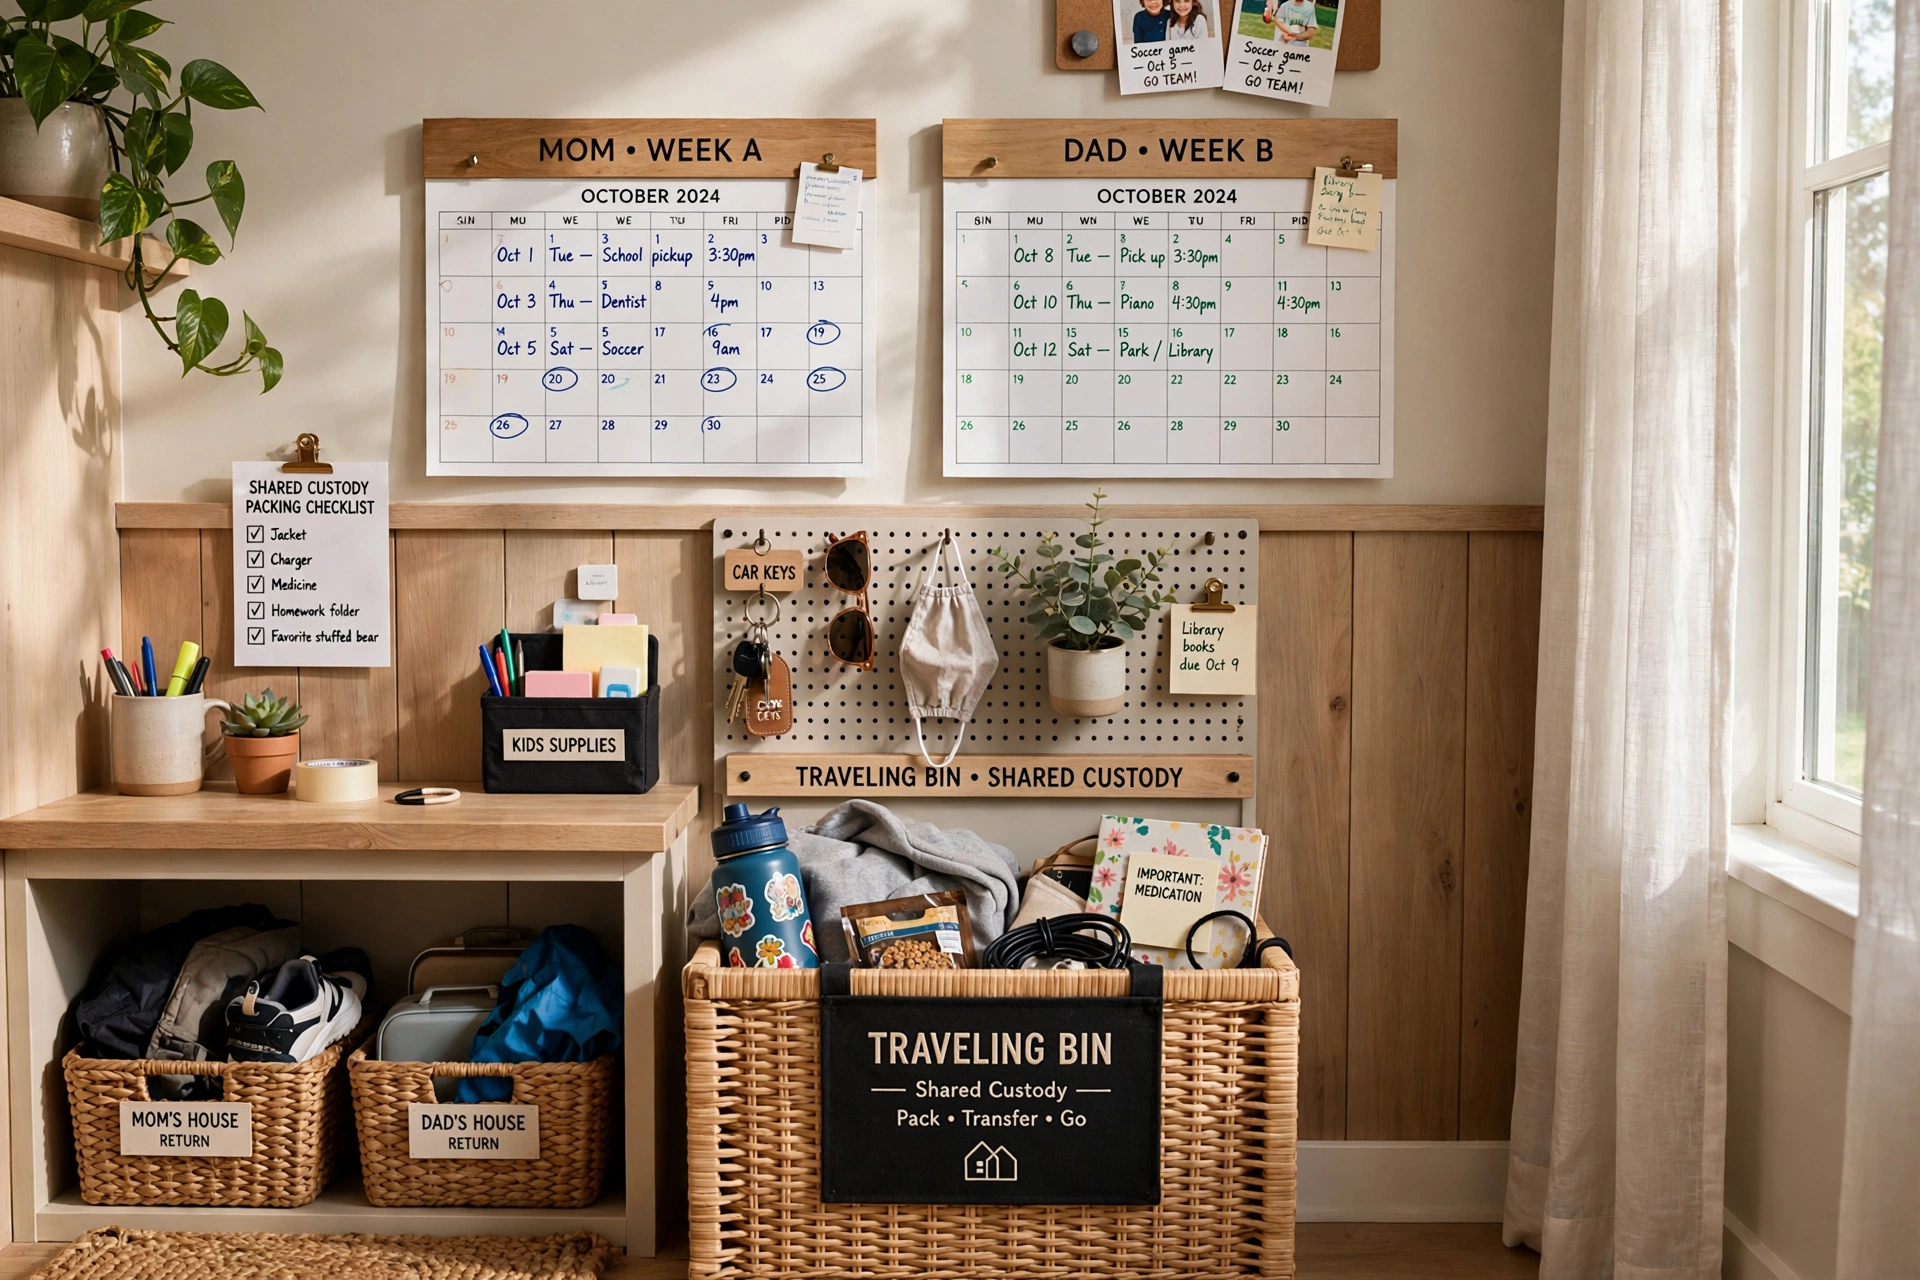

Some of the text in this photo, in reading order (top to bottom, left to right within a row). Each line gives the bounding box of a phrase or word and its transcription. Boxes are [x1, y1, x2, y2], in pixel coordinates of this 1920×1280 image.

[1131, 45, 1195, 59] Soccer game
[1244, 41, 1311, 65] Soccer game
[1148, 58, 1177, 72] Oct 5
[1254, 59, 1285, 75] Oct 5
[1144, 71, 1198, 87] GO TEAM!
[1245, 75, 1303, 94] GO TEAM!
[539, 138, 762, 162] MOM WEEK A
[1065, 139, 1273, 162] DAD WEEK B
[582, 189, 720, 203] OCTOBER 2024
[1098, 189, 1237, 203] OCTOBER 2024
[563, 216, 578, 224] WE
[616, 216, 631, 225] WE
[723, 217, 737, 225] FRI
[1028, 217, 1043, 225] MU
[1133, 217, 1149, 225] WE
[498, 247, 520, 262] Oct
[549, 247, 573, 262] Tue
[603, 247, 642, 262] School
[652, 247, 692, 267] pickup
[709, 248, 754, 267] 3:30pm
[1014, 247, 1218, 268] Oct 8 Tue Pick up 3:30pm
[761, 281, 824, 290] 10 13
[1279, 281, 1341, 291] 11 13
[497, 293, 738, 313] Oct 3 Thu Dentist 4pm
[1014, 294, 1320, 315] Oct 10 Thu Piano 4:30pm 4:30pm
[655, 327, 665, 336] 17
[761, 327, 772, 337] 17
[814, 327, 824, 337] 19
[961, 327, 1340, 338] 10 11 15 15 16 17 18 16
[498, 340, 740, 355] Oct 5 Sat Soccer 9am
[1014, 342, 1213, 364] Oct 12 Sat Park Library
[549, 374, 562, 384] 20
[602, 374, 615, 383] 20
[655, 374, 665, 383] 21
[707, 374, 719, 384] 23
[761, 374, 773, 383] 24
[813, 374, 825, 384] 25
[962, 374, 1342, 384] 18 19 20 20 22 22 23 24
[497, 420, 720, 430] 26 27 28 29 30
[961, 421, 1289, 431] 26 26 25 26 28 29 30
[250, 480, 369, 495] SHARED CUSTODY
[246, 500, 374, 514] PACKING CHECKLIST
[271, 528, 307, 540] Jacket
[271, 553, 312, 570] Charger
[733, 565, 795, 580] CAR KEYS
[272, 577, 316, 590] Medicine
[272, 603, 360, 616] Homework folder
[272, 629, 379, 642] Favorite stuffed bear
[1183, 621, 1224, 644] Library
[1183, 639, 1214, 652] books
[1180, 657, 1239, 671] due Oct 9
[513, 737, 616, 753] KIDS SUPPLIES
[796, 766, 1183, 788] TRAVELING BIN SHARED CUSTODY
[1138, 868, 1204, 886] IMPORTANT:
[1135, 884, 1202, 902] MEDICATION
[868, 1032, 1111, 1065] TRAVELING BIN
[916, 1080, 1067, 1102] Shared Custody
[132, 1111, 238, 1128] MOM'S HOUSE
[422, 1114, 525, 1131] DAD'S HOUSE
[898, 1109, 1086, 1126] Pack Transfer Go
[160, 1134, 209, 1147] RETURN
[449, 1137, 499, 1150] RETURN
